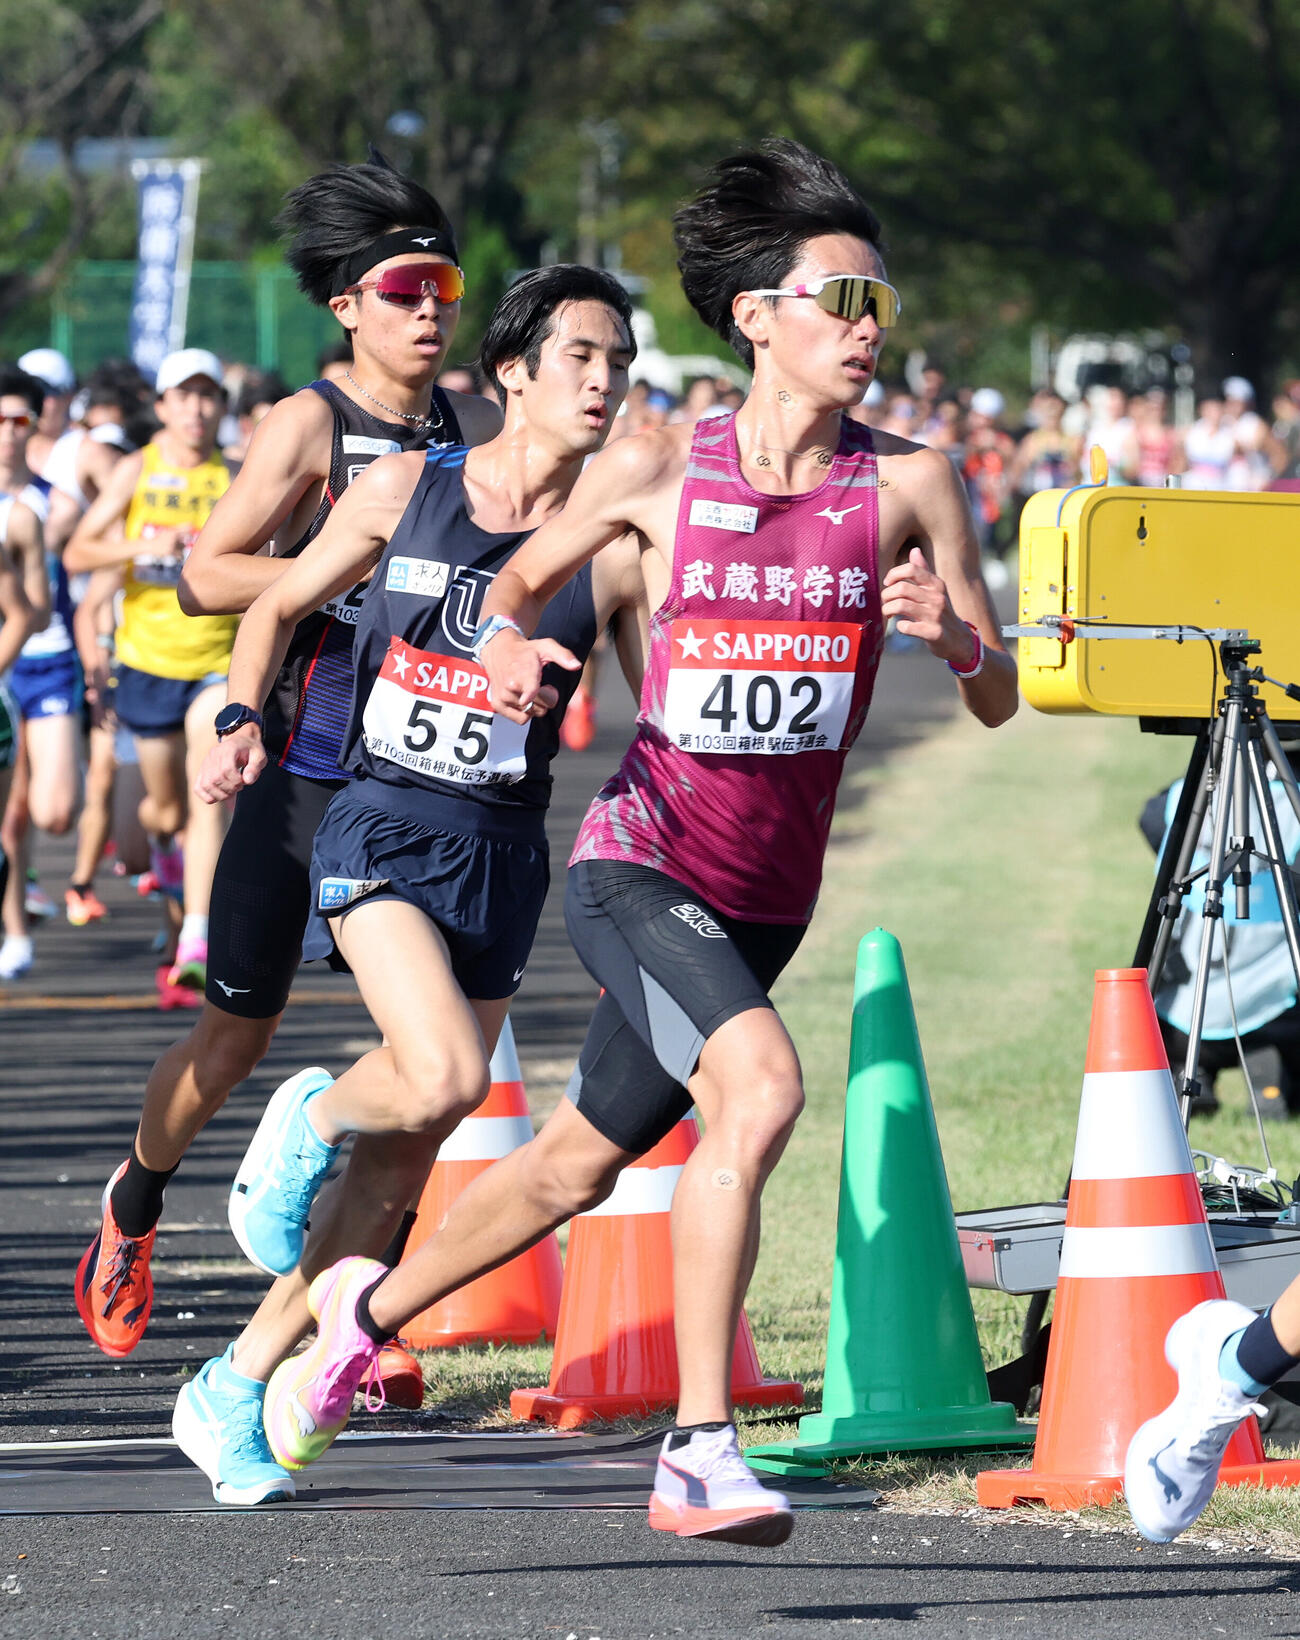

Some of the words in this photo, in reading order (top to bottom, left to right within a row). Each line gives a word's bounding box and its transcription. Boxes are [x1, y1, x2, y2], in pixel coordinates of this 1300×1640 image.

[415, 562, 445, 581] 求人
[681, 559, 869, 609] 武蔵野学院
[712, 631, 850, 663] SAPPORO
[413, 662, 491, 701] SAPP
[701, 674, 822, 735] 402
[668, 903, 729, 939] 2XU
